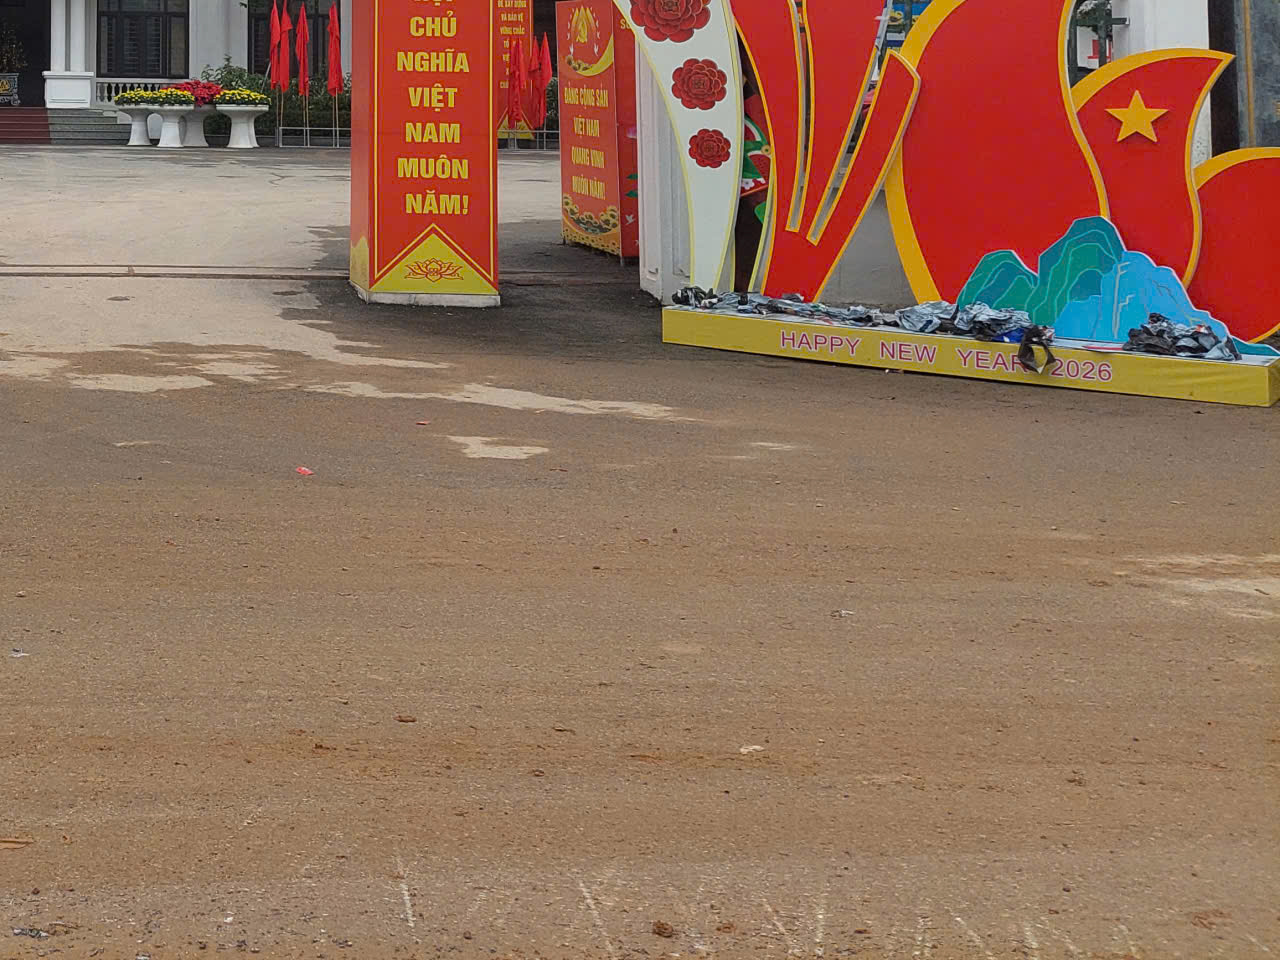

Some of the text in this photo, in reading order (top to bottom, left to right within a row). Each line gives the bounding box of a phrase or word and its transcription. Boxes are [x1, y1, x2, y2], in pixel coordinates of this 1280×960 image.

[410, 10, 457, 37] CHỦ
[396, 48, 469, 73] NGHĨA
[408, 83, 458, 112] VIỆT
[405, 123, 460, 143] NAM
[586, 119, 600, 137] NAM
[397, 154, 468, 179] MUÔN
[405, 189, 469, 215] NĂM!
[779, 330, 862, 357] HAPPY
[879, 340, 938, 365] NEW
[1050, 357, 1113, 383] 2026
